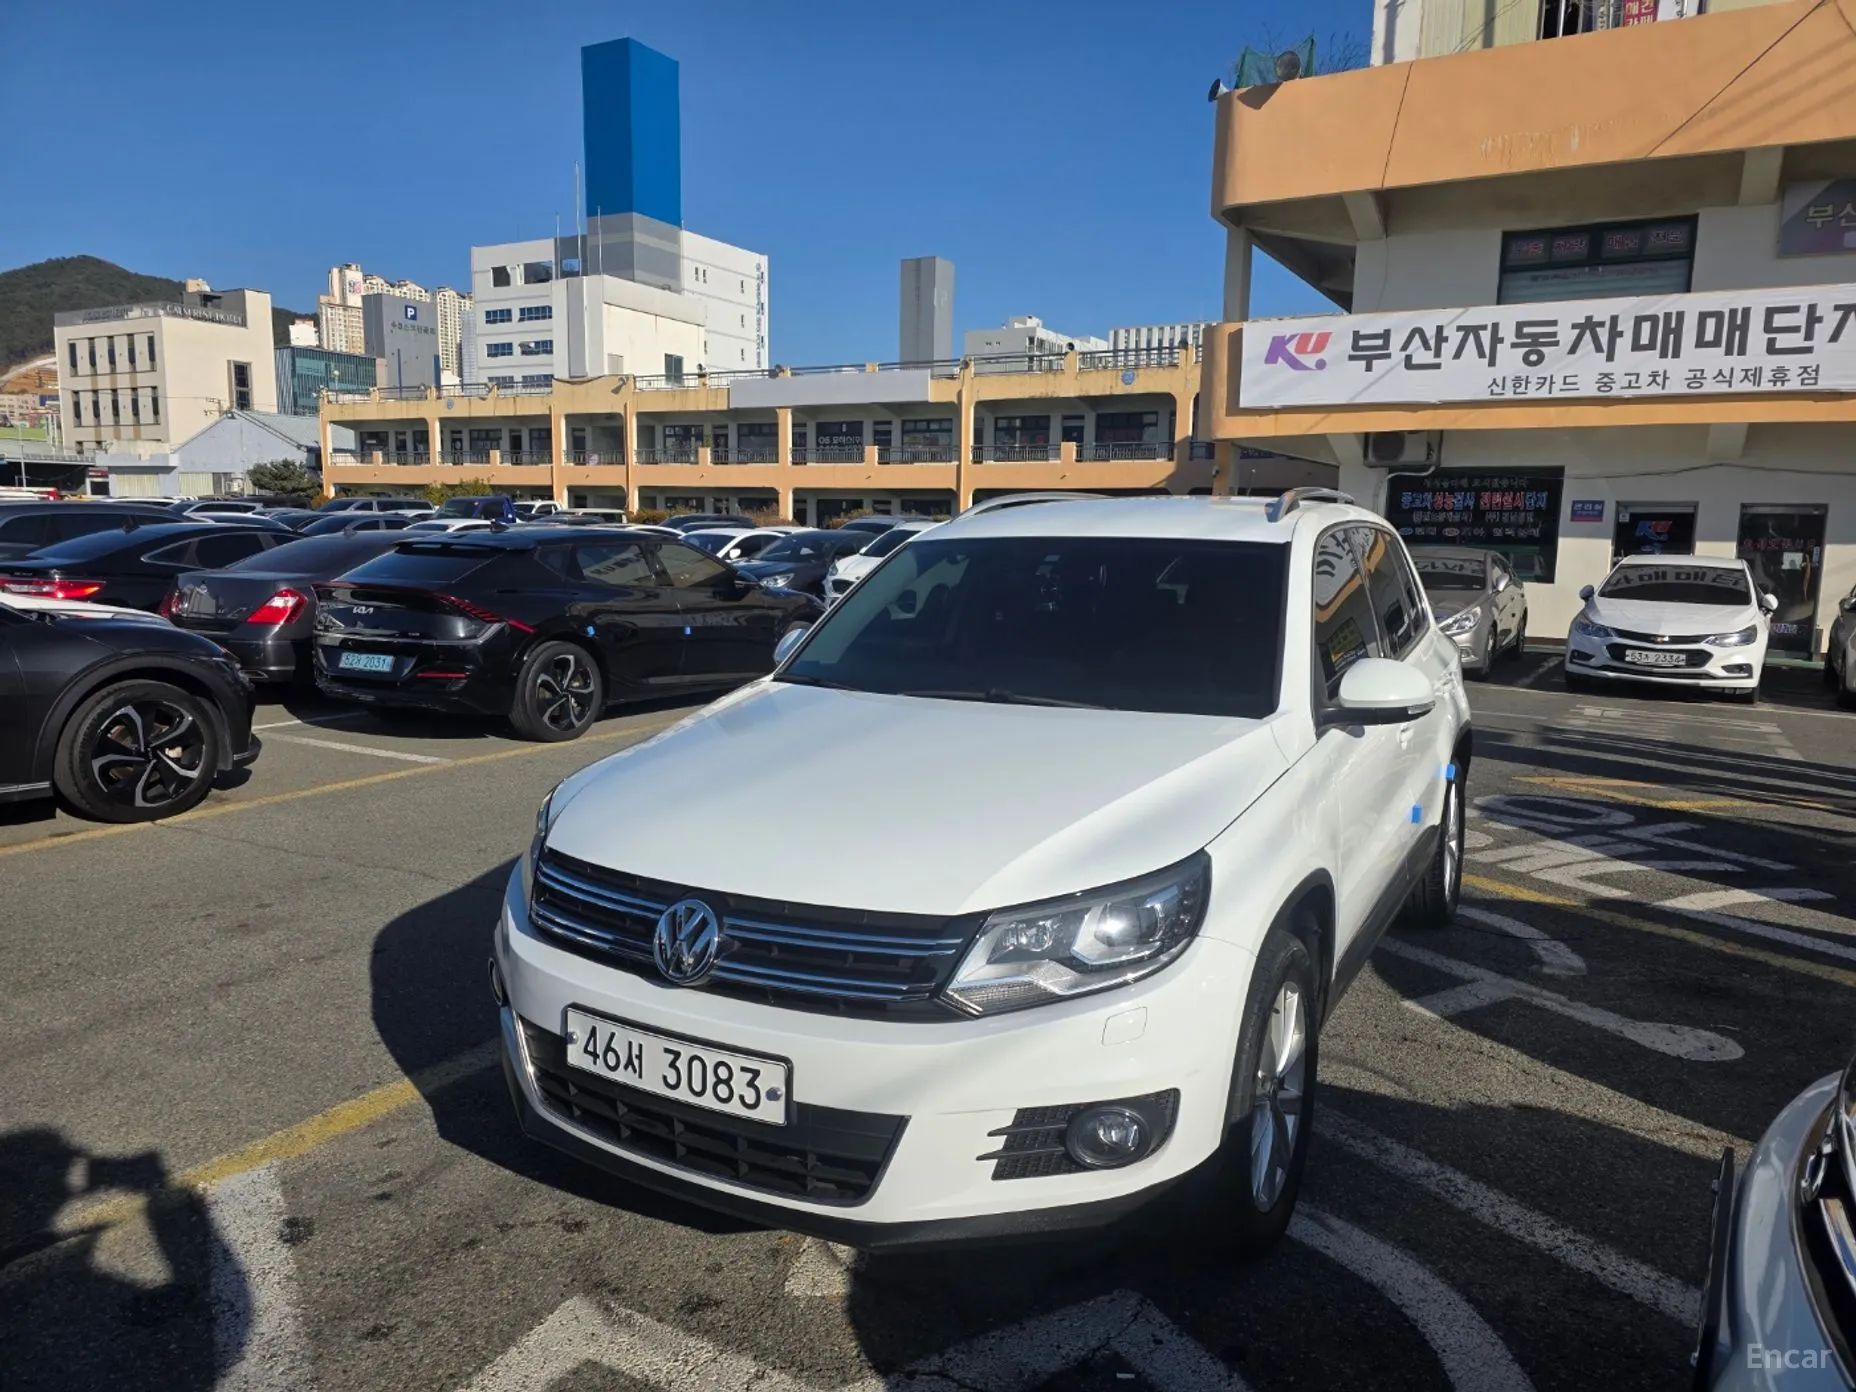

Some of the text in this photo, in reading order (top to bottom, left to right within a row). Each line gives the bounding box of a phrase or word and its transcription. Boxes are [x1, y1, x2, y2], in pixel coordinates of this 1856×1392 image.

[407, 307, 415, 319] P
[1487, 363, 1821, 396] 신한카드 중고차 공식제휴점
[583, 1026, 761, 1110] 46서 3083
